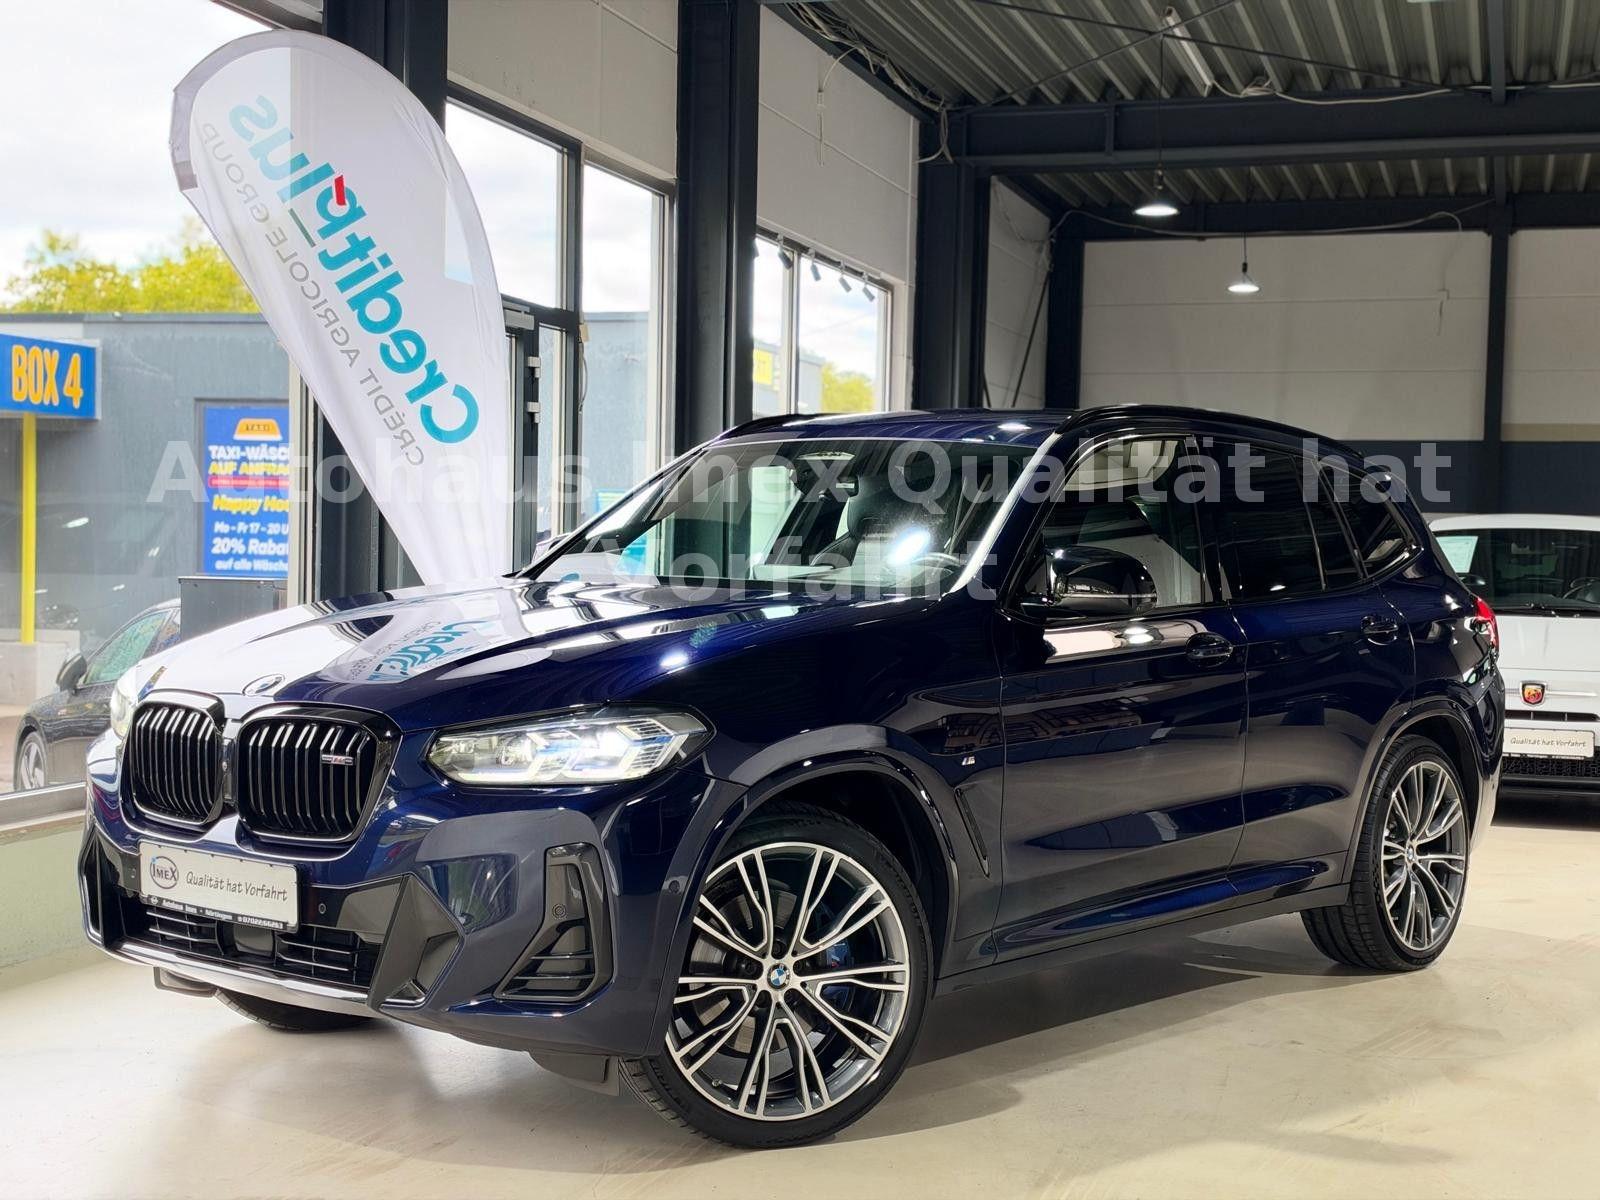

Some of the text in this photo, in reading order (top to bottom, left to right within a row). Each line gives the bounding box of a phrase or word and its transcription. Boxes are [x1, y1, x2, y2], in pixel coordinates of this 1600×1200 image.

[12, 345, 83, 409] BOX 4
[208, 443, 289, 461] TAXI-WÄSC
[239, 462, 289, 476] ANFRA
[212, 494, 263, 516] Happy
[211, 537, 247, 555] 20%
[186, 870, 288, 902] Qualität hat Vorfahrt
